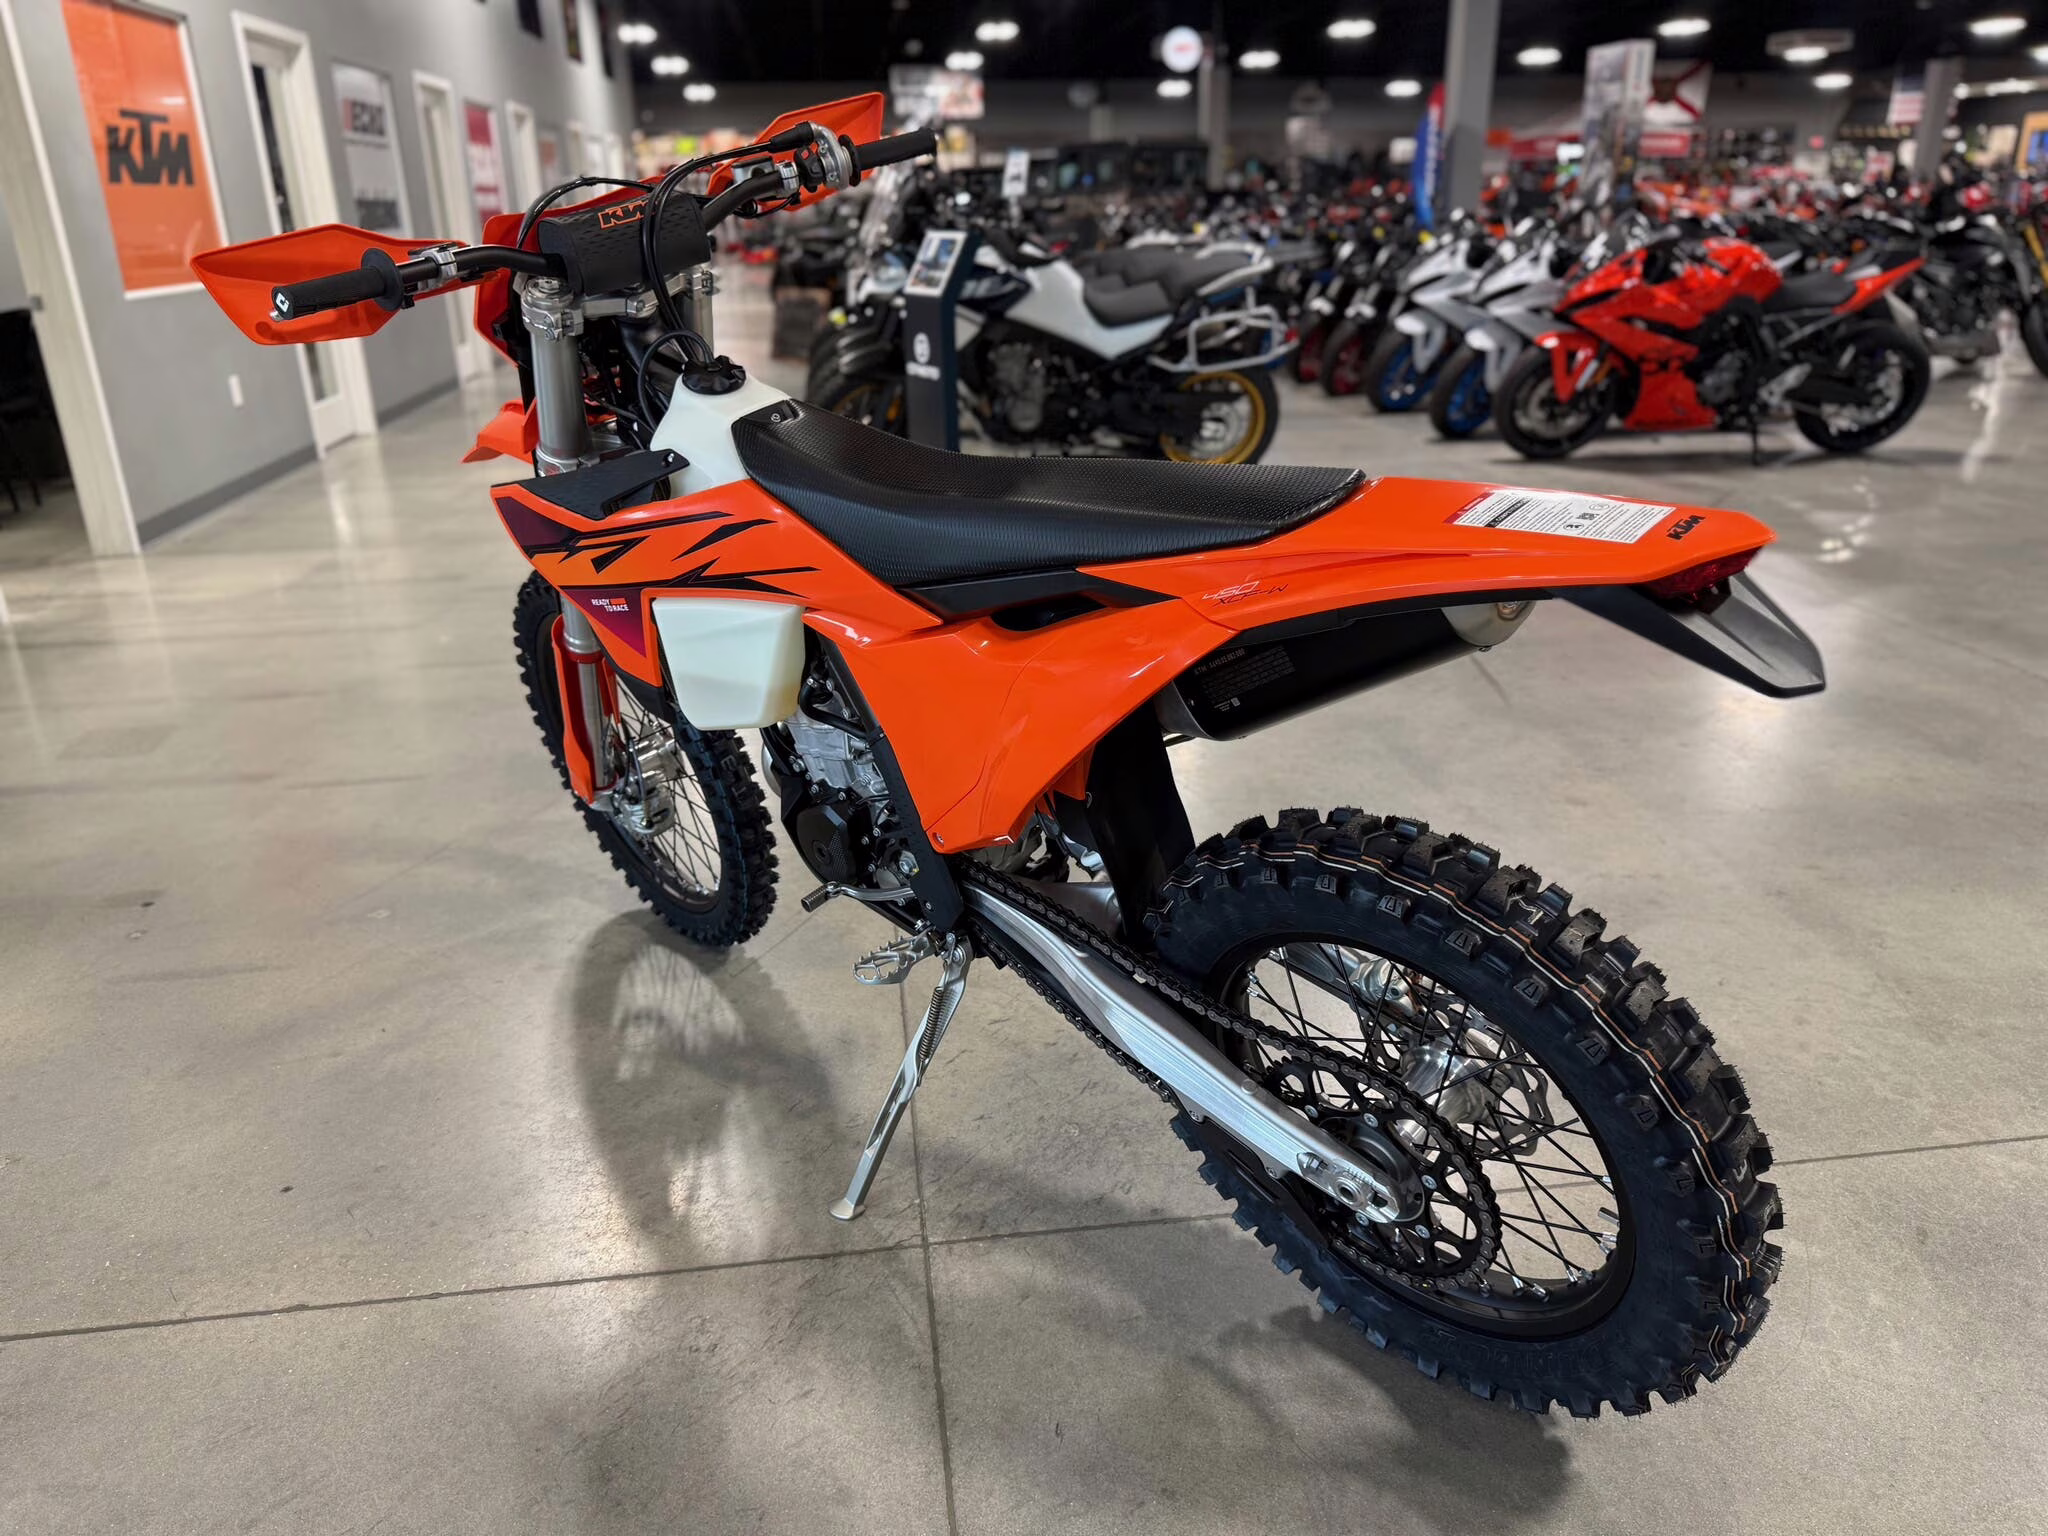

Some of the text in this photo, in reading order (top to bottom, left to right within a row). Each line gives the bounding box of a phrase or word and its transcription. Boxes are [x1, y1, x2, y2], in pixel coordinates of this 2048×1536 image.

[106, 108, 195, 186] KTM
[1665, 514, 1706, 540] KTM
[591, 598, 609, 606] READY
[612, 604, 630, 612] RACE
